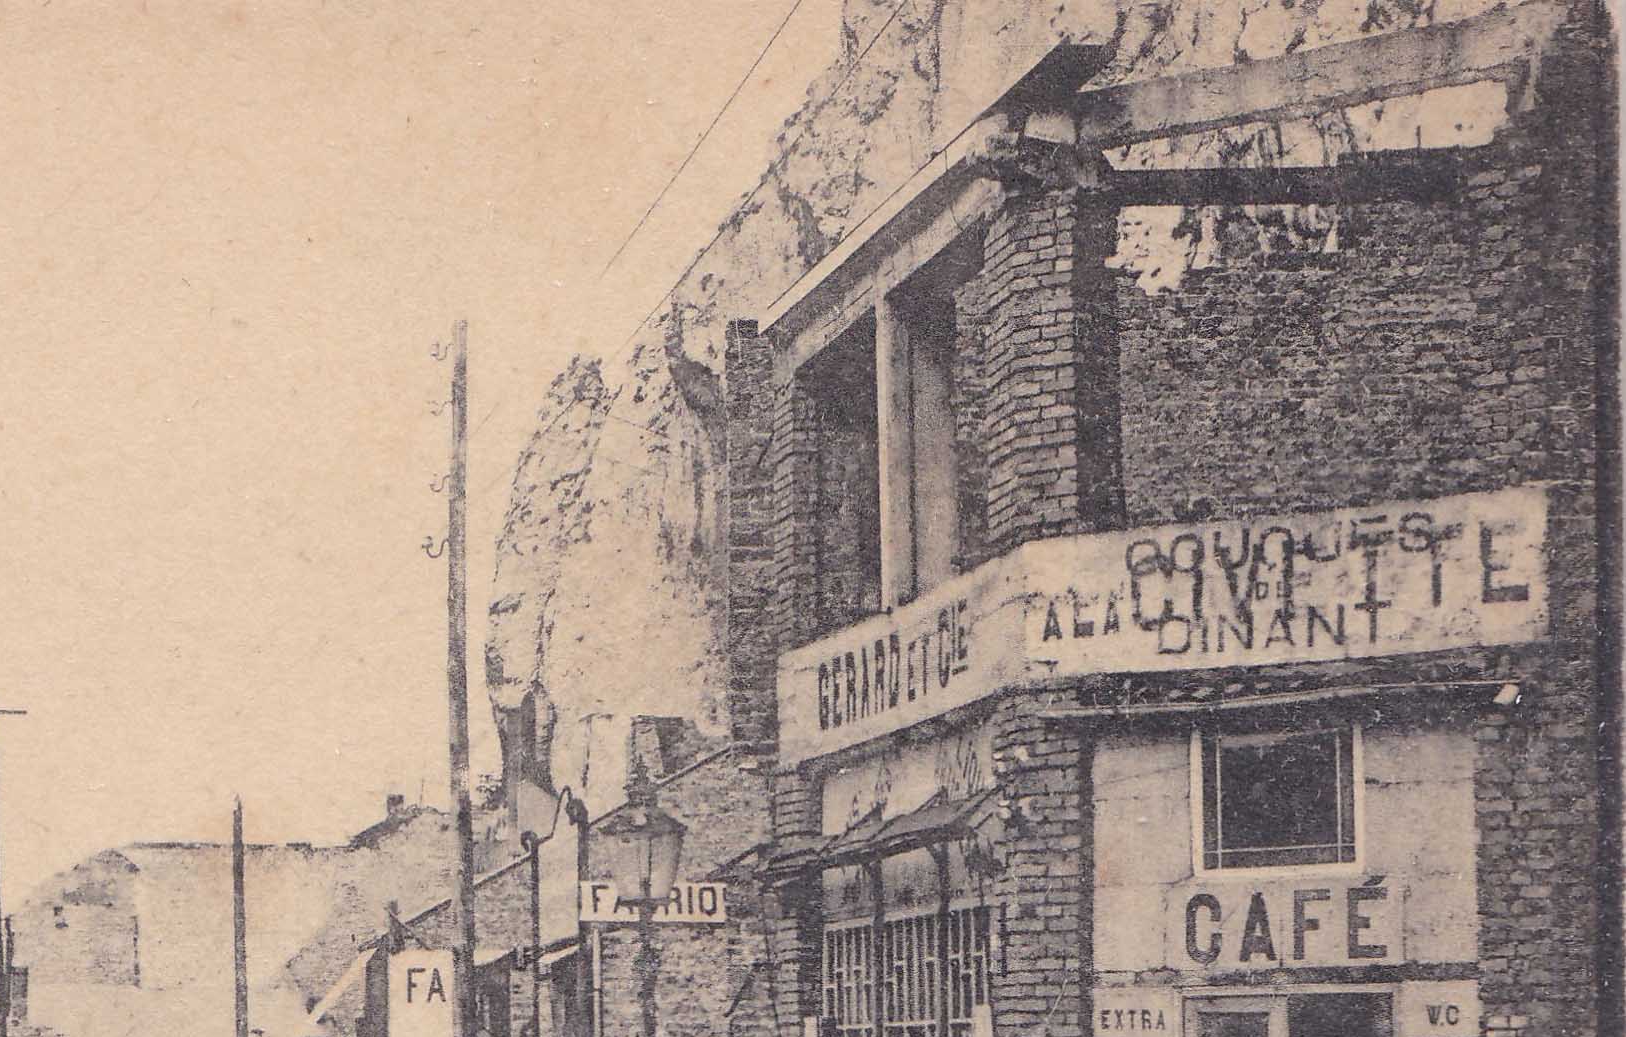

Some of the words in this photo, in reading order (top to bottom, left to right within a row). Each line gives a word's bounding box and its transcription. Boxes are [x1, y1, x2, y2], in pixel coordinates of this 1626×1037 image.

[1158, 600, 1392, 656] DINANT
[1185, 876, 1389, 964] CAFÉ
[1100, 1008, 1166, 1030] EXTRA
